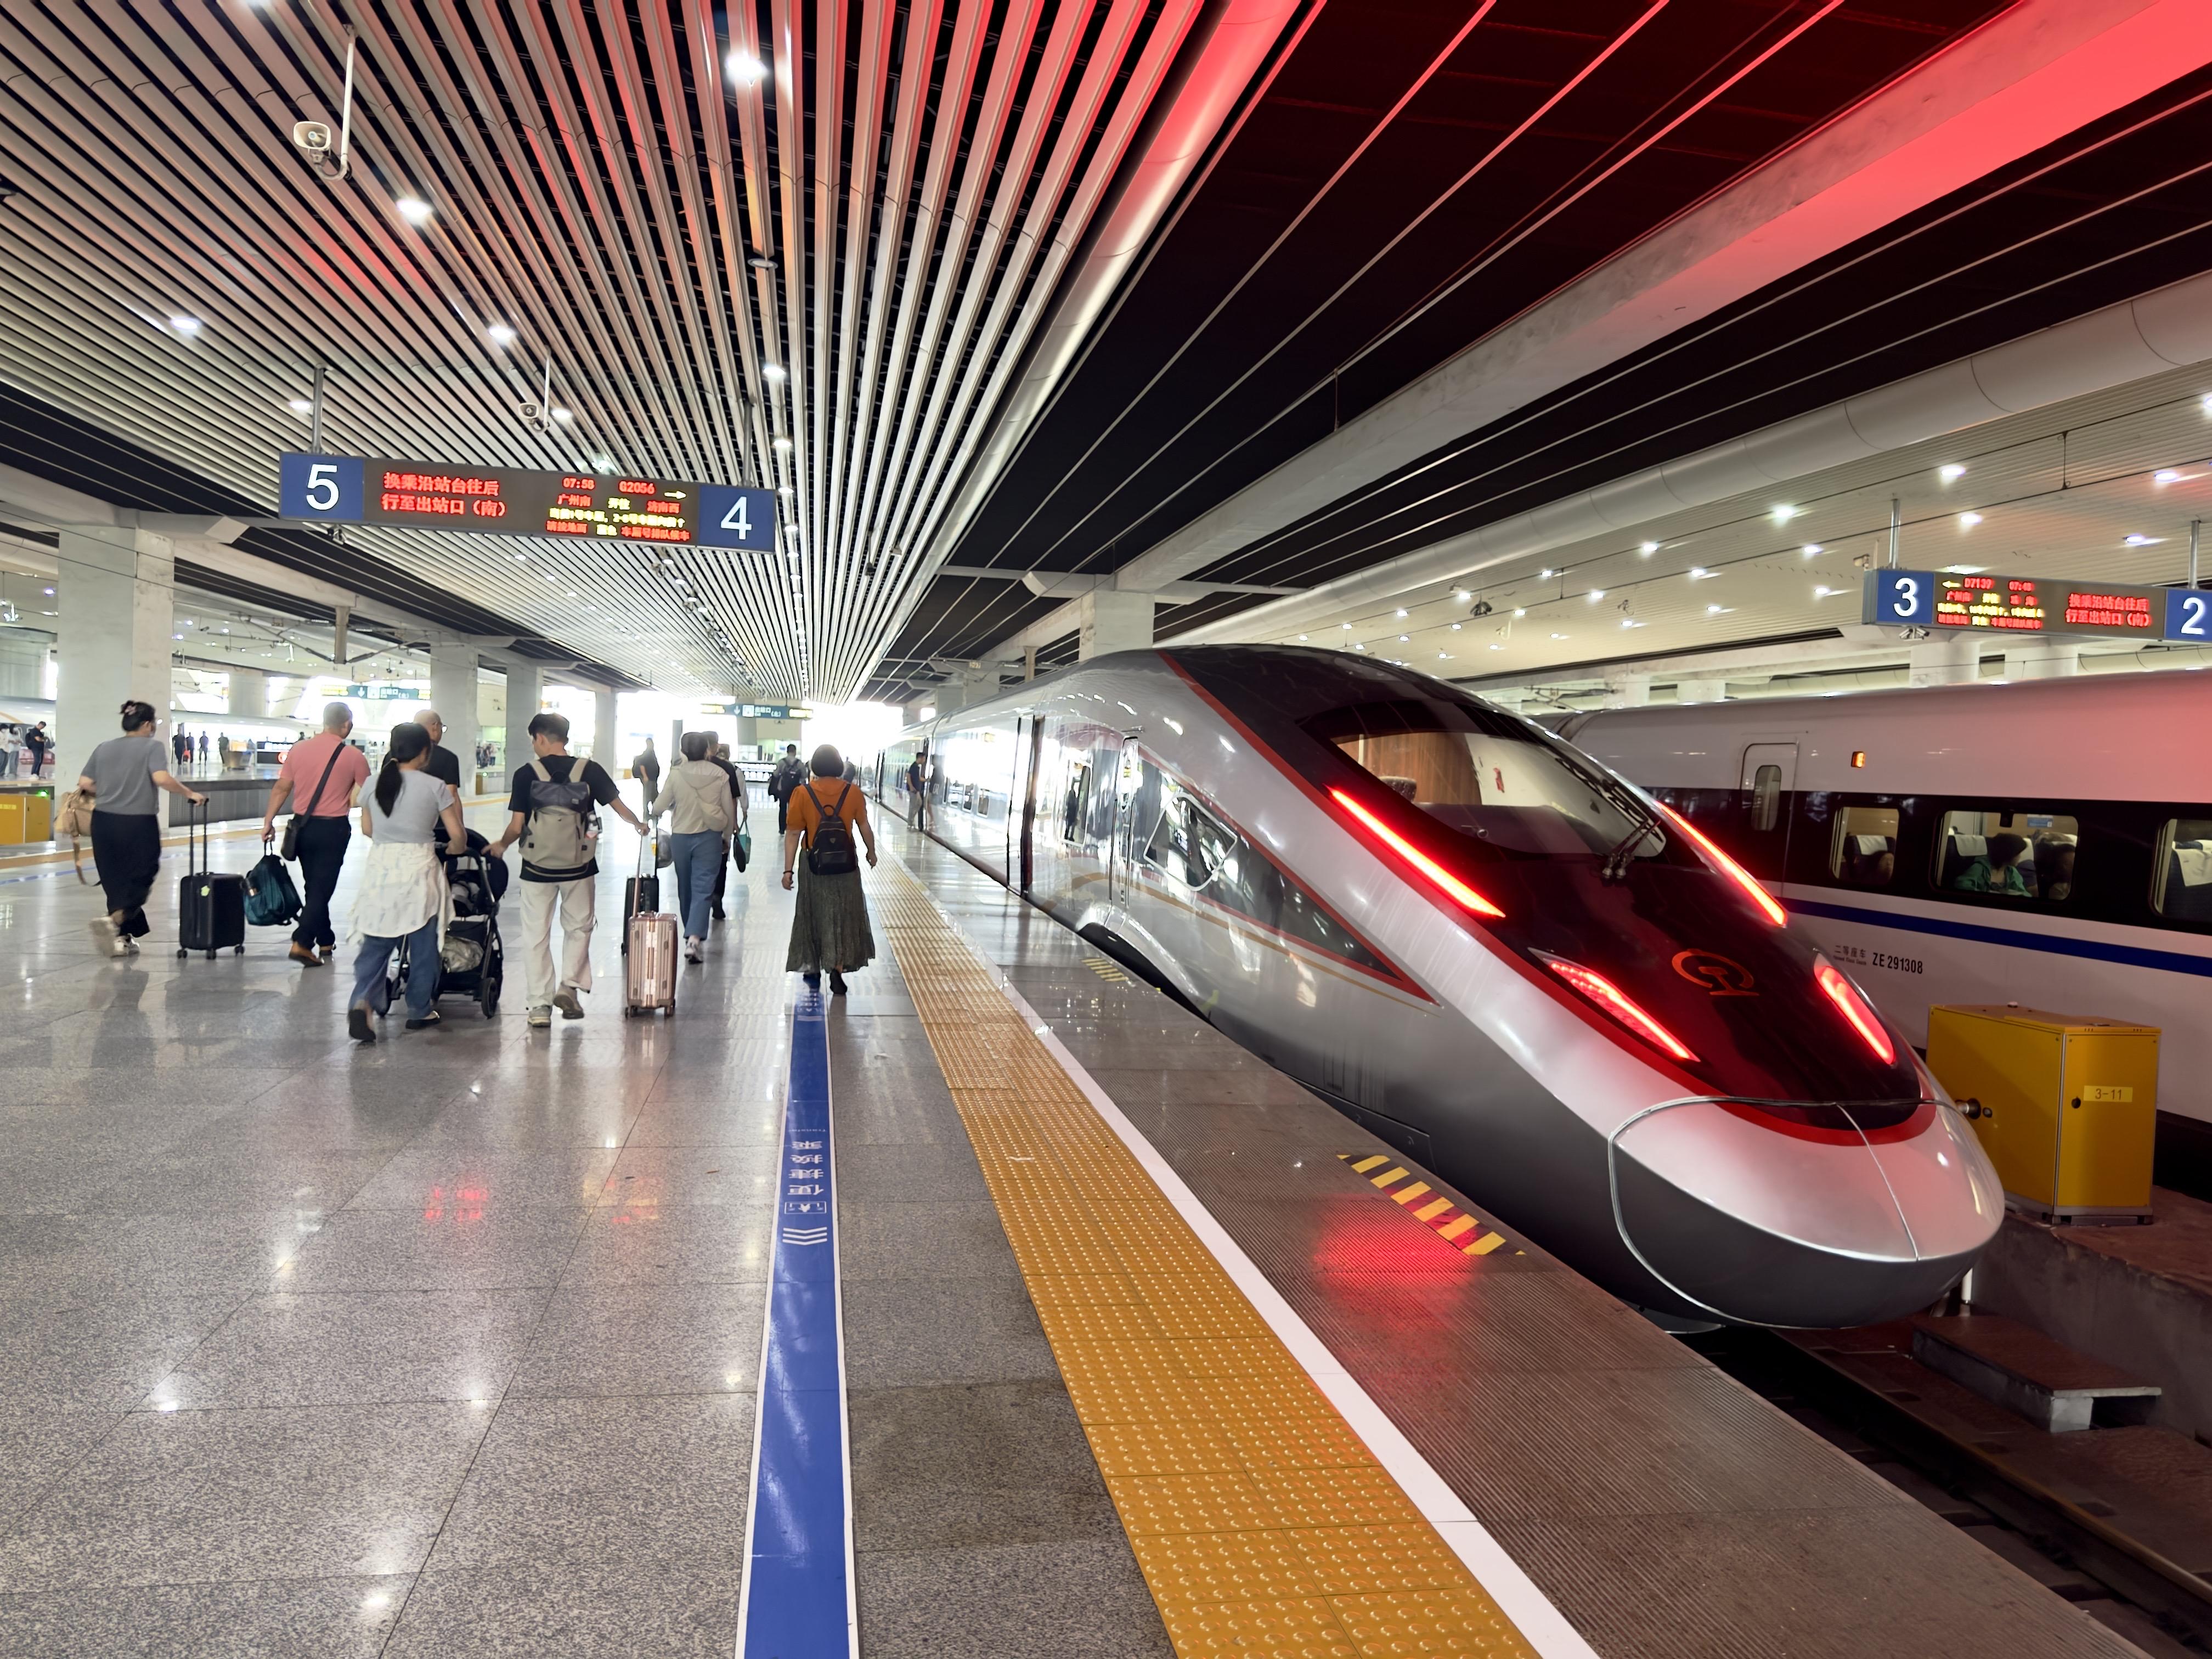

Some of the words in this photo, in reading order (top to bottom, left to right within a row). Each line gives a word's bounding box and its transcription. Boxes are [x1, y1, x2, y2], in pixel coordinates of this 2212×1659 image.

[306, 464, 340, 510] 5
[384, 472, 500, 496] 换乘沿站台往后
[562, 477, 595, 490] 07:58
[619, 481, 656, 495] G2056
[557, 494, 591, 507] 广州南
[720, 496, 752, 540] 4
[1894, 578, 1917, 617] 3
[2069, 593, 2149, 612] 换乘沿站台往后
[2181, 597, 2205, 635] 2
[1872, 952, 1885, 968] ZE
[1887, 955, 1923, 974] 291308
[2095, 1088, 2123, 1101] 3-11
